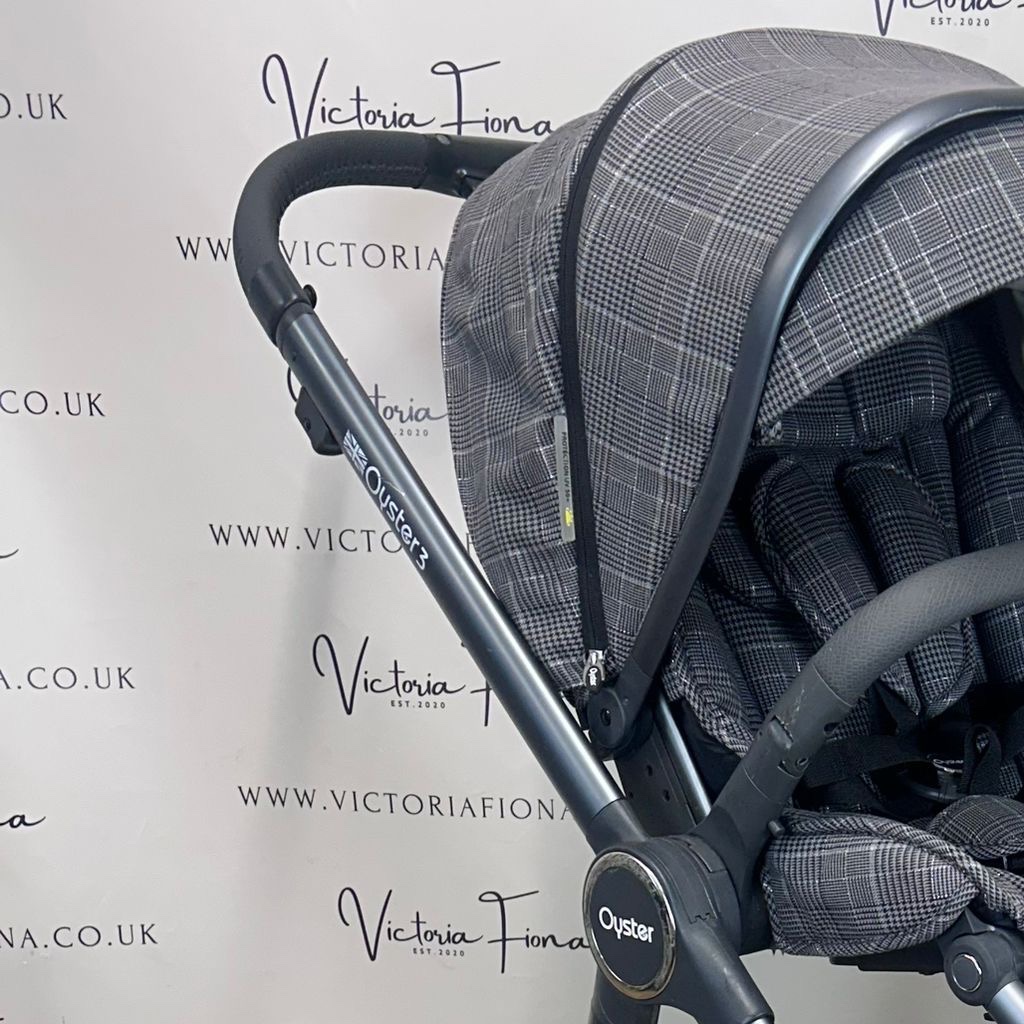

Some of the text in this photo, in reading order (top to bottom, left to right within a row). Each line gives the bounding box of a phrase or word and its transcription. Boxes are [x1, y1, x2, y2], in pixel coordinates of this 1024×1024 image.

[931, 17, 989, 26] EST.2020
[262, 54, 554, 138] Victoria Fiona
[312, 633, 466, 716] Victoria
[391, 700, 445, 709] EST.2020
[338, 887, 589, 974] Victoria Fiona
[598, 906, 654, 944] Oyster
[413, 948, 464, 957] EST.2020
